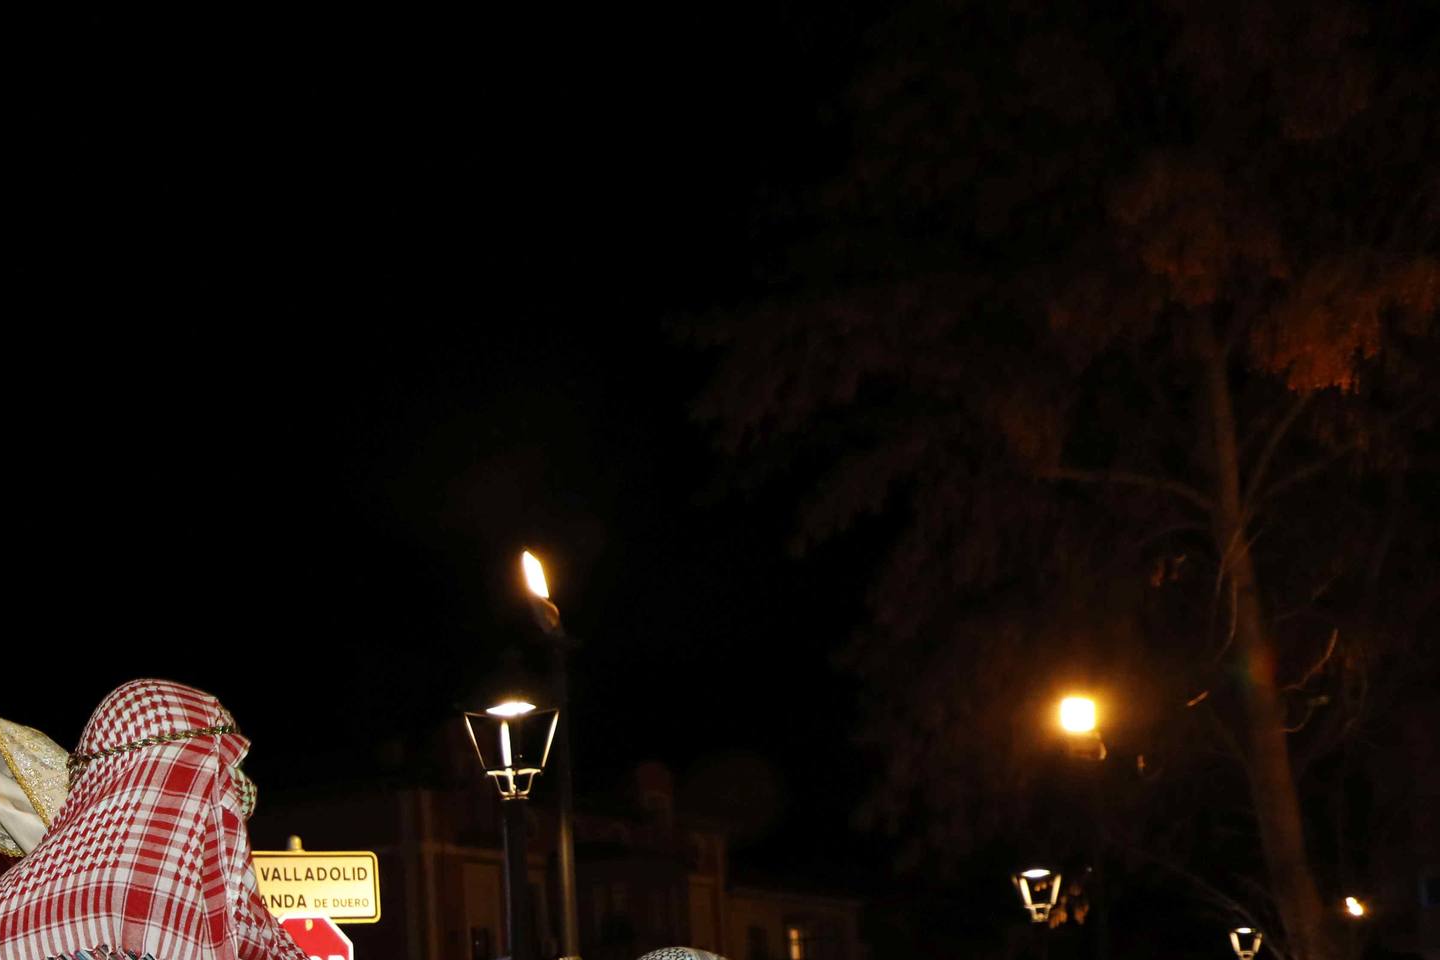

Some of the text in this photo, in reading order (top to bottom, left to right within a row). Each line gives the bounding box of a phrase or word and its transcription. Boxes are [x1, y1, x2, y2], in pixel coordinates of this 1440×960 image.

[260, 866, 368, 882] VALLADOLID
[261, 894, 369, 909] ANDA DE DUERO
